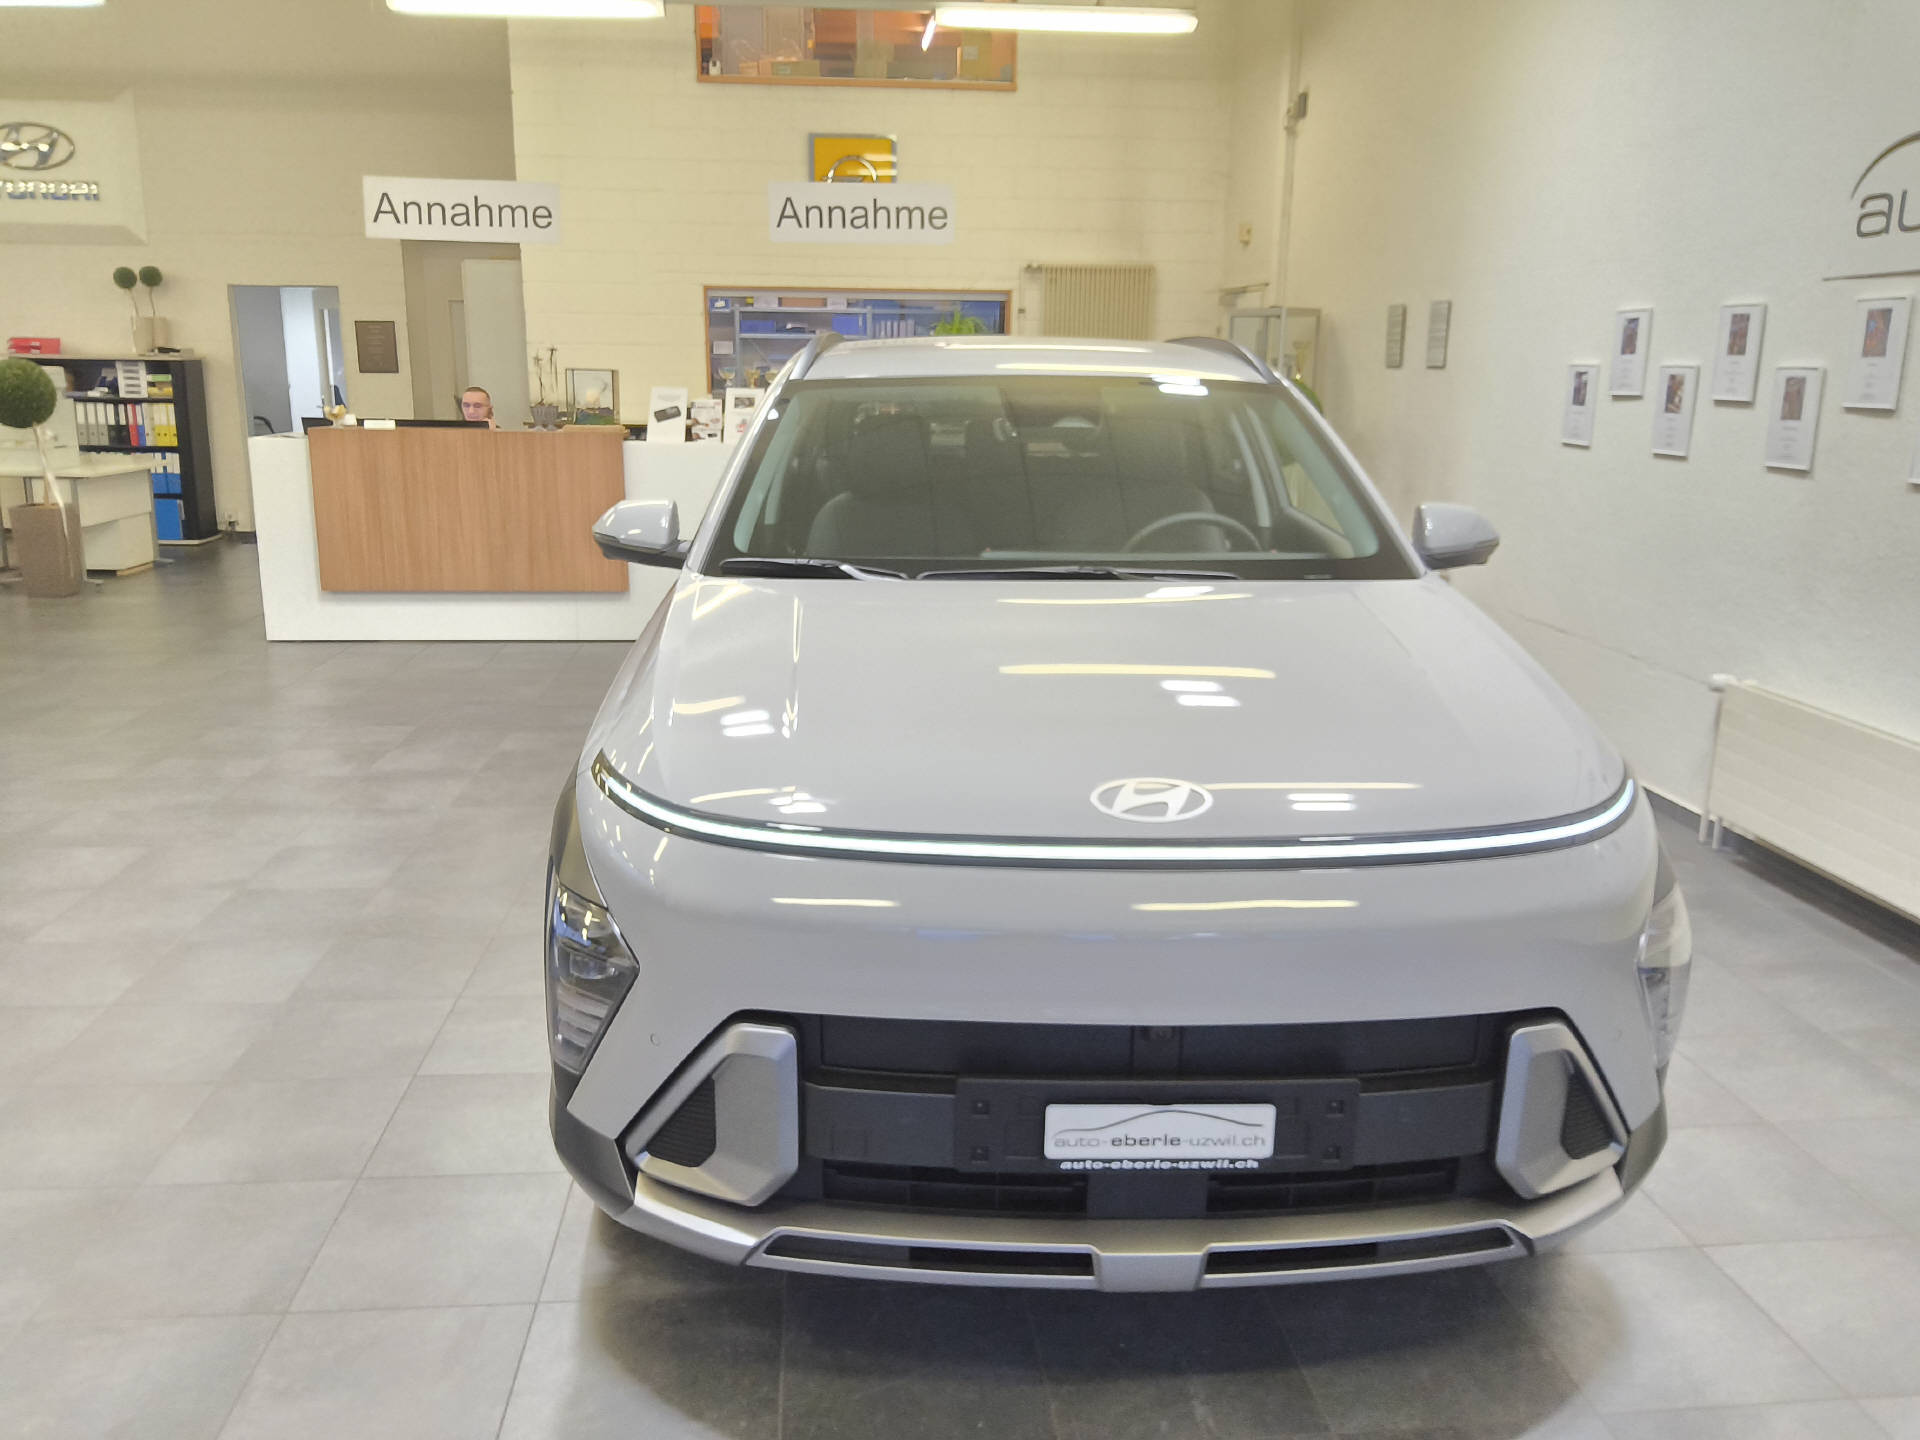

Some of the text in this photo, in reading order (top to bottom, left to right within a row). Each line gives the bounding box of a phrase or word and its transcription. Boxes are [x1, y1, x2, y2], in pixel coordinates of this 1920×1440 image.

[0, 180, 100, 200] UNDAI
[373, 192, 552, 229] Annahme
[777, 197, 948, 230] Annahme
